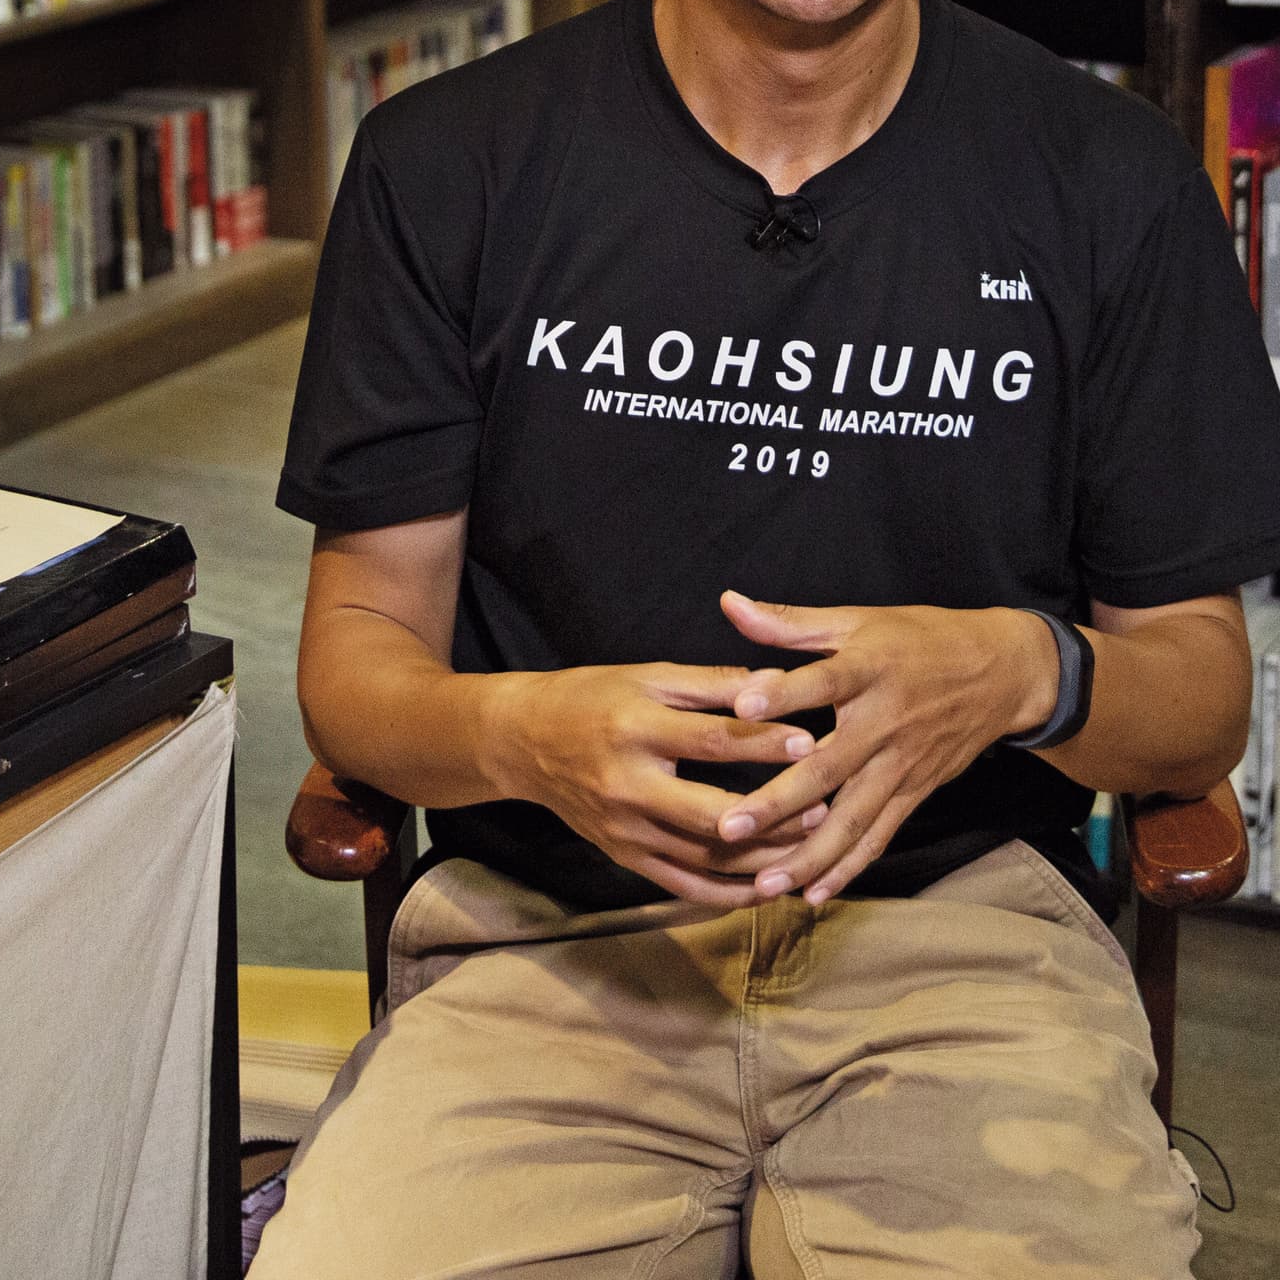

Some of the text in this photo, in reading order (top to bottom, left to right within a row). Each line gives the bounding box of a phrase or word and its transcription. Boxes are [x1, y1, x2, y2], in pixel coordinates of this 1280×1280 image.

[526, 317, 1035, 402] KAOHSIUNG
[583, 388, 974, 438] INTERNATIONAL MARATHON
[728, 443, 830, 478] 2019
